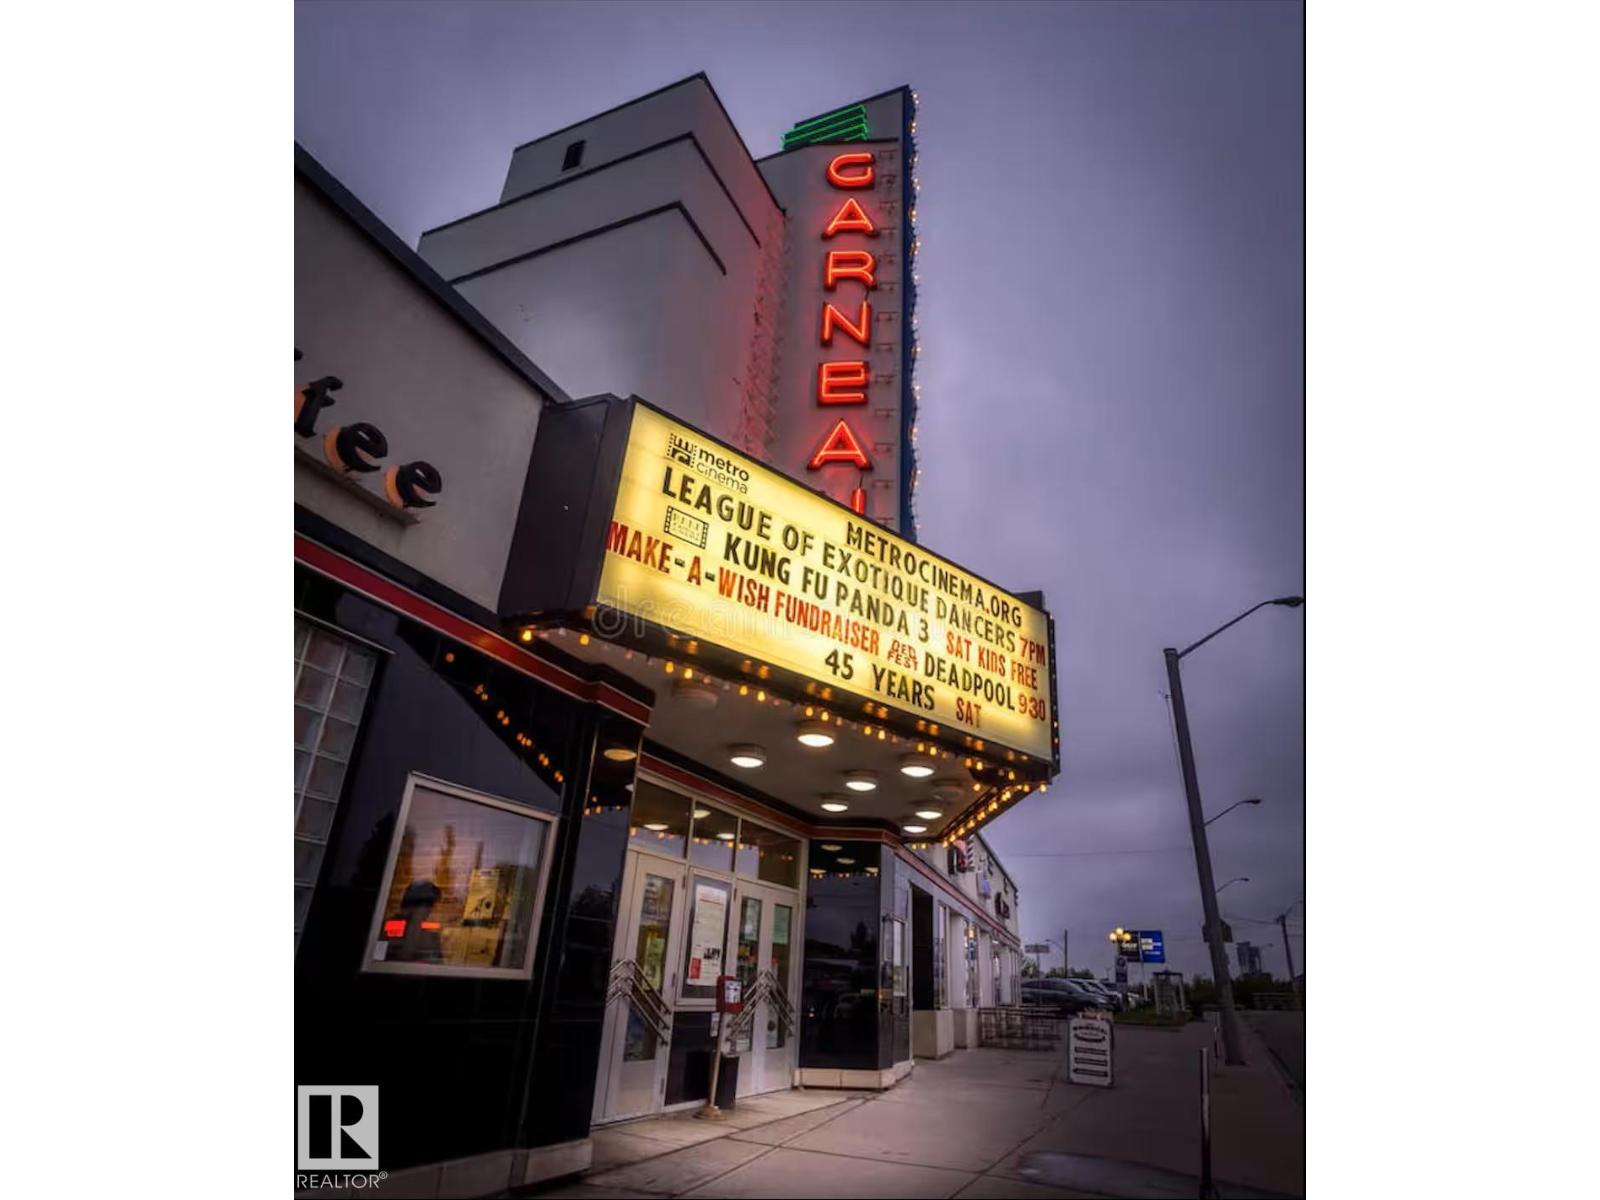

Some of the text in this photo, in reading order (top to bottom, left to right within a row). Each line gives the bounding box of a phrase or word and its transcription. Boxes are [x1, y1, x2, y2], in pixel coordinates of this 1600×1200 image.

[696, 462, 749, 494] cinema
[698, 448, 750, 482] metro
[662, 466, 772, 541] LEAGUE
[782, 524, 814, 556] OF
[822, 541, 929, 614] EXOTIQUE
[936, 596, 1016, 653] DANCERS
[1020, 635, 1045, 666] 7PM
[846, 521, 1022, 628] METROCINEMA.ORG
[723, 532, 791, 585] KUNG
[801, 566, 829, 601] FU
[836, 581, 909, 637] PANDA
[918, 619, 929, 643] 3
[946, 630, 972, 662] SAT
[1010, 659, 1037, 690] FREE
[774, 590, 880, 656] FUNDRAISER
[825, 649, 981, 728] 45 YEARS SAT
[887, 650, 918, 671] FEST
[924, 651, 1046, 722] DEADPOOL 930
